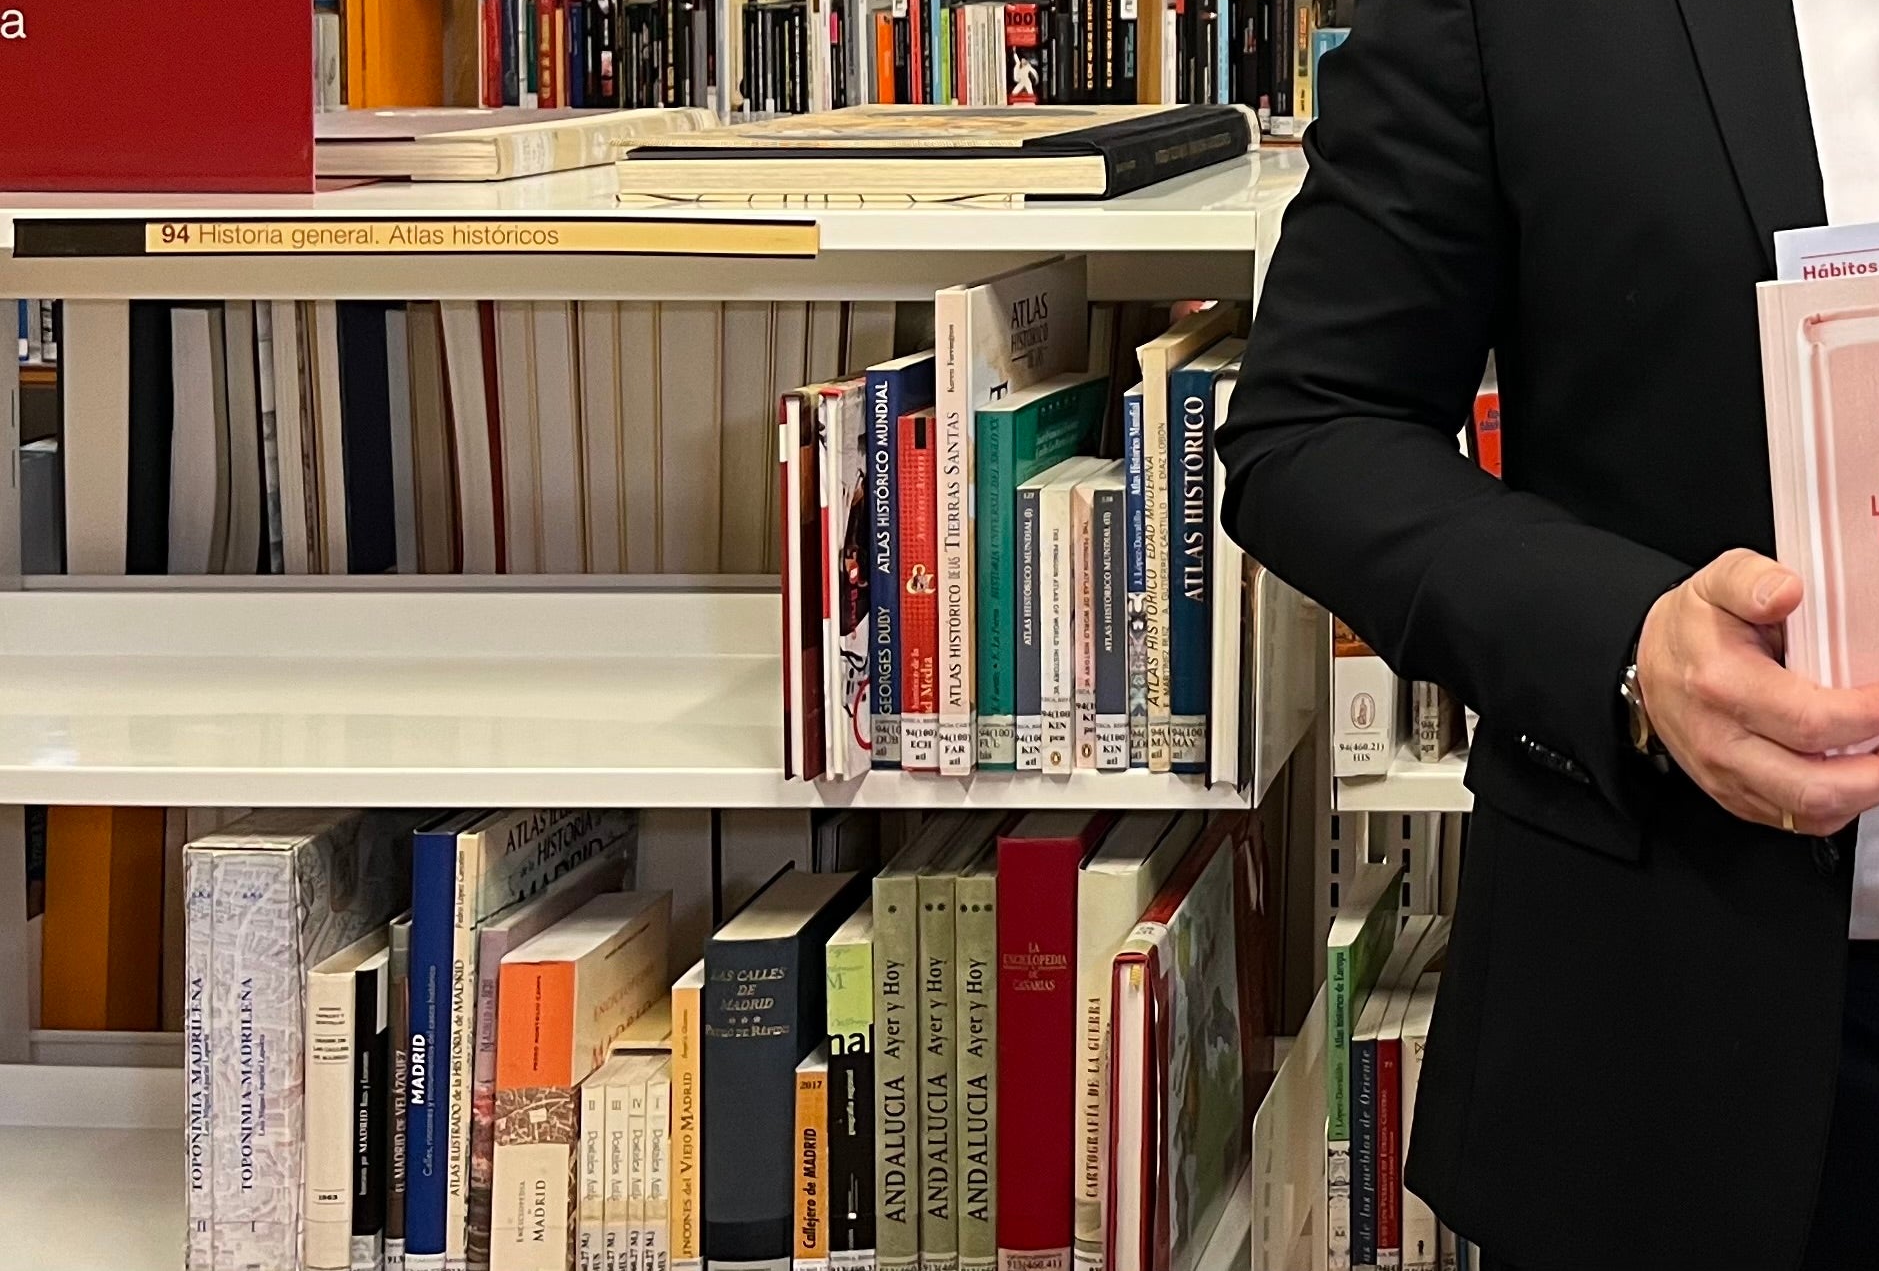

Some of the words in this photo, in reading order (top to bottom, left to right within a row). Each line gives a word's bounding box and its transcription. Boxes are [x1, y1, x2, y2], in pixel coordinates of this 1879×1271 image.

[1006, 12, 1038, 26] 1001
[161, 225, 190, 242] 94
[199, 224, 283, 244] Historia
[292, 225, 379, 249] general.
[388, 224, 446, 244] Atlas
[452, 223, 559, 244] históricos
[1803, 258, 1878, 280] Hábitos
[1011, 292, 1048, 330] ATLAS
[875, 380, 889, 447] MUNDIAL
[944, 412, 960, 475] SANTAS
[1180, 396, 1205, 526] HISTÓRICO
[873, 451, 890, 527] HISTÓRICO
[1144, 456, 1155, 519] MODERNA
[944, 481, 960, 554] TIERRAS
[876, 530, 890, 574] ATLAS
[1145, 524, 1155, 559] EDAD
[1183, 529, 1204, 602] ATLAS
[878, 607, 891, 644] DUBY
[946, 584, 961, 659] HISTÓRICO
[1024, 618, 1032, 646] ATLAS
[1104, 622, 1112, 653] ATLAS
[879, 648, 892, 715] GEORGES
[949, 662, 962, 707] ATLAS
[1147, 657, 1159, 707] ATLAS
[1353, 754, 1371, 762] HIS
[505, 810, 547, 855] ATLAS
[536, 811, 593, 867] HISTORIA
[453, 959, 465, 1013] MADRID
[737, 967, 786, 981] CALLES
[737, 984, 756, 996] DE
[883, 959, 905, 996] Hoy
[926, 956, 948, 993] Hoy
[967, 958, 988, 994] Hoy
[458, 1015, 465, 1027] de
[721, 998, 775, 1011] MADRID
[887, 1002, 905, 1016] y
[930, 999, 948, 1012] y
[970, 1000, 988, 1014] y
[1088, 997, 1101, 1052] GUERRA
[884, 1016, 905, 1059] Ayer
[927, 1014, 948, 1056] Ayer
[967, 1015, 988, 1058] Ayer
[411, 1034, 427, 1105] MADRID
[800, 1080, 822, 1090] 2017
[1088, 1057, 1100, 1076] LA
[1359, 1049, 1371, 1105] Oriente
[681, 1071, 694, 1131] MADRID
[1088, 1081, 1100, 1100] DE
[191, 1084, 202, 1192] TOPONIMIA
[240, 1084, 252, 1193] TOPONIMIA
[359, 1109, 368, 1153] MADRID
[452, 1104, 462, 1165] ILUSTRADO
[1359, 1112, 1370, 1128] de
[394, 1134, 405, 1178] MADRID
[680, 1135, 693, 1174] VIEJO
[803, 1128, 817, 1178] MADRID
[885, 1075, 906, 1224] ANDALUCIA
[927, 1073, 948, 1220] ANDALUCIA
[967, 1073, 989, 1223] ANDALUCIA
[1085, 1104, 1100, 1198] CARTOGRAFÍA
[1359, 1135, 1374, 1191] pueblos
[450, 1166, 460, 1197] ATLAS
[682, 1178, 692, 1195] del
[806, 1179, 816, 1190] de
[533, 1180, 546, 1242] MADRID
[803, 1192, 816, 1249] Callejero
[1360, 1195, 1370, 1217] los
